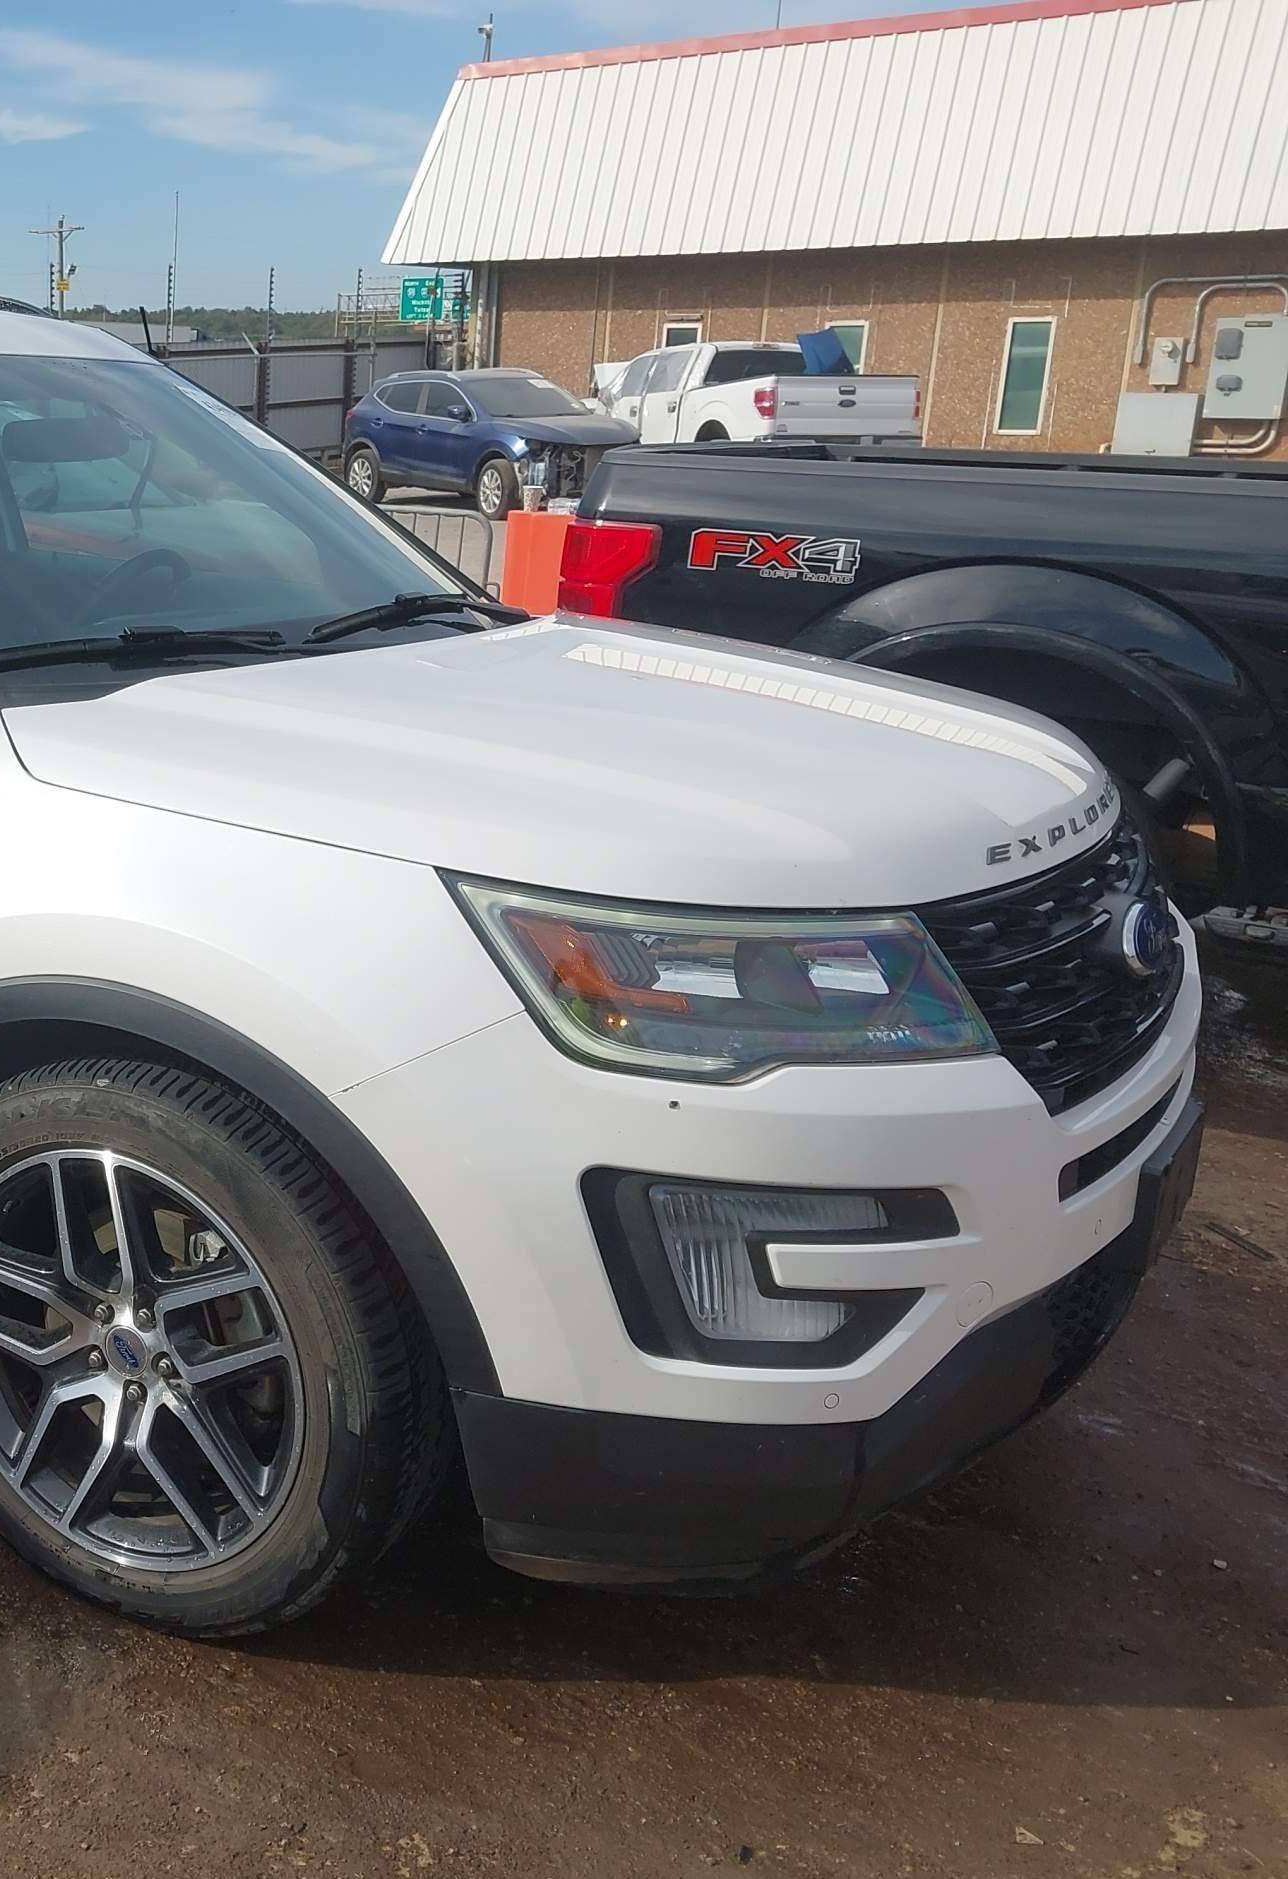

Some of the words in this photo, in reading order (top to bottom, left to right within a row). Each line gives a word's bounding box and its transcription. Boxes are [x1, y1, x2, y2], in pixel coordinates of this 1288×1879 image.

[687, 527, 861, 576] FX4
[759, 569, 798, 580] OFF
[802, 572, 855, 585] ROAD
[986, 768, 1115, 866] EXPLORE
[114, 1339, 137, 1365] Ford
